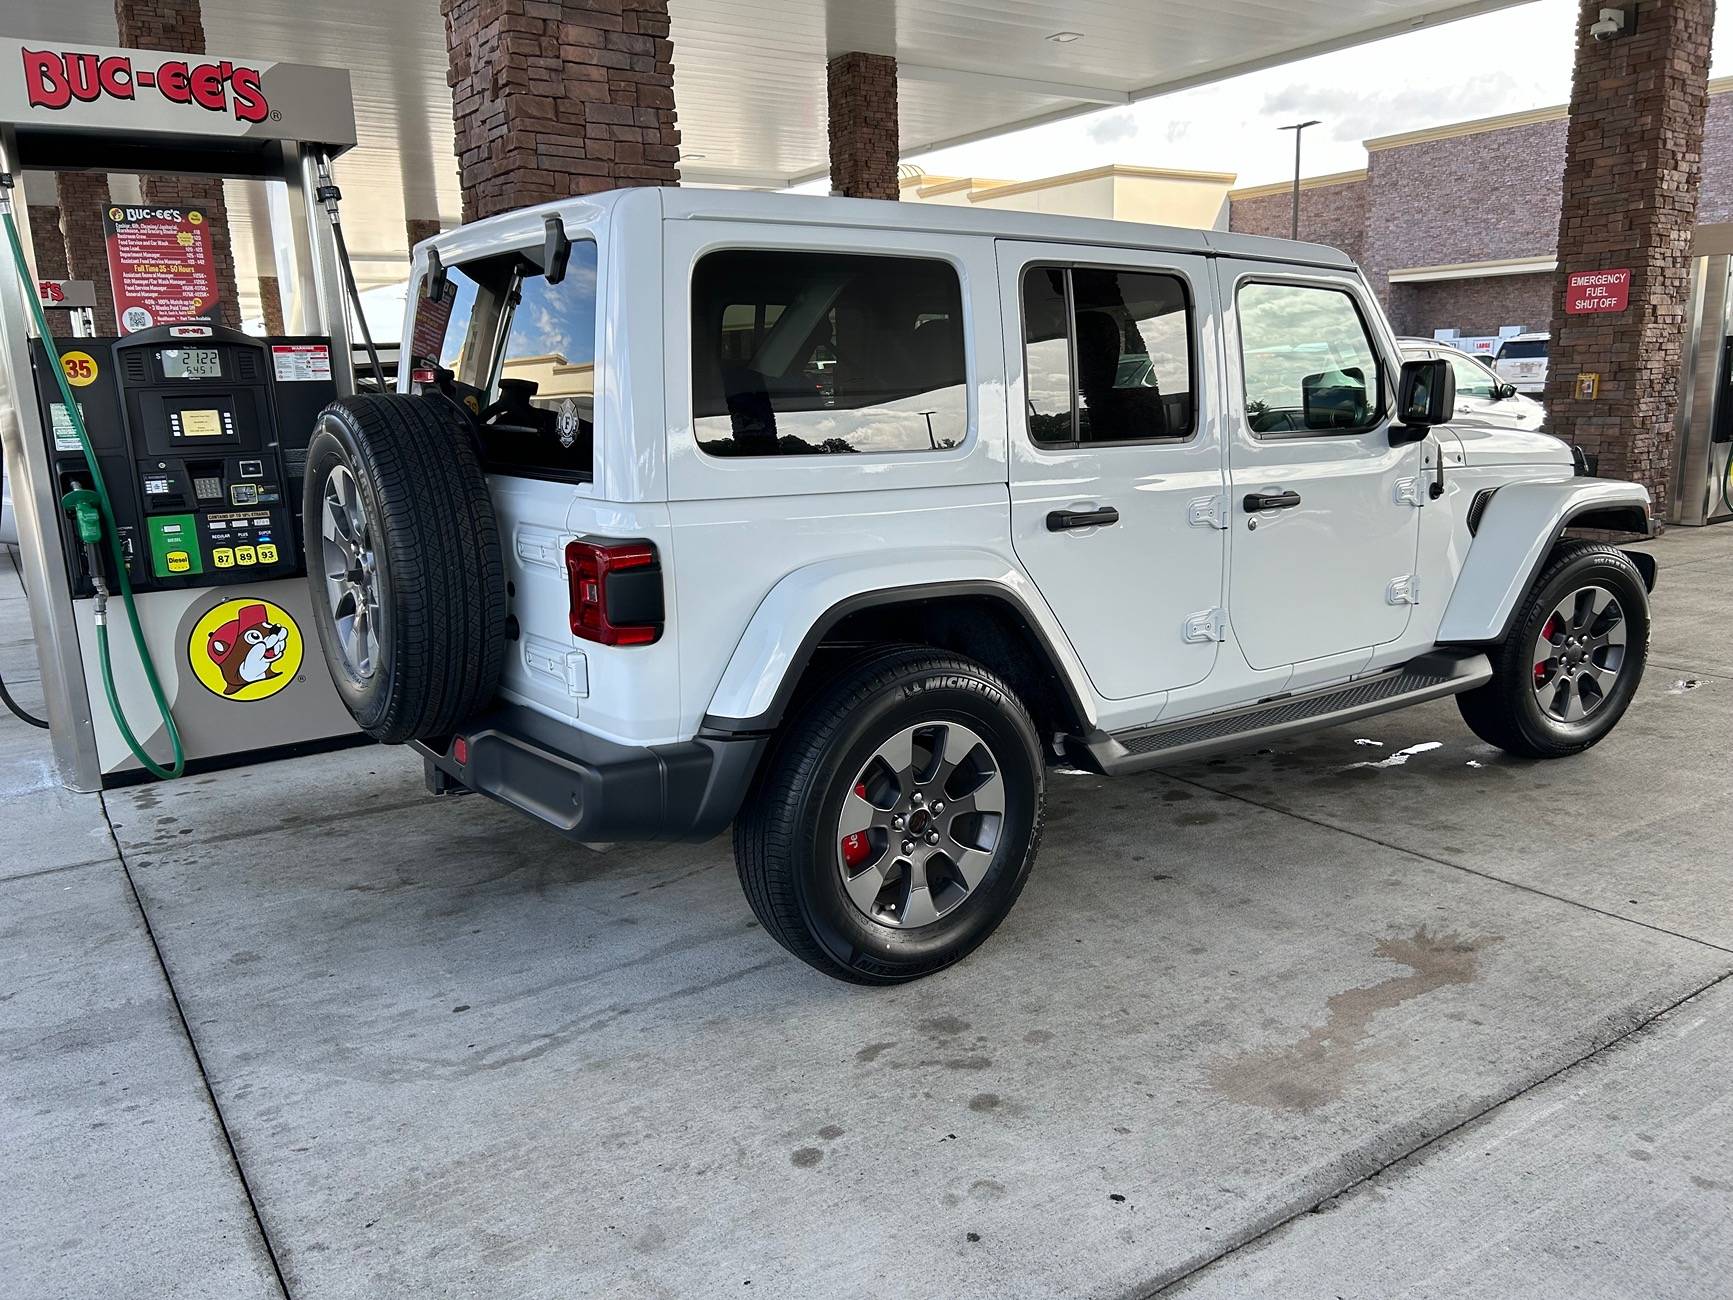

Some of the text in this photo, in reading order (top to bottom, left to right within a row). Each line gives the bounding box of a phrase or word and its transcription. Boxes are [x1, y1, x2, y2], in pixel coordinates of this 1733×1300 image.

[1571, 273, 1626, 286] EMERGENCY
[1586, 287, 1608, 297] FUEL
[1575, 298, 1617, 309] SHUT OFF
[65, 360, 92, 378] 35
[240, 553, 252, 561] 89
[925, 676, 1002, 705] MICHELIN
[849, 834, 858, 848] Je
